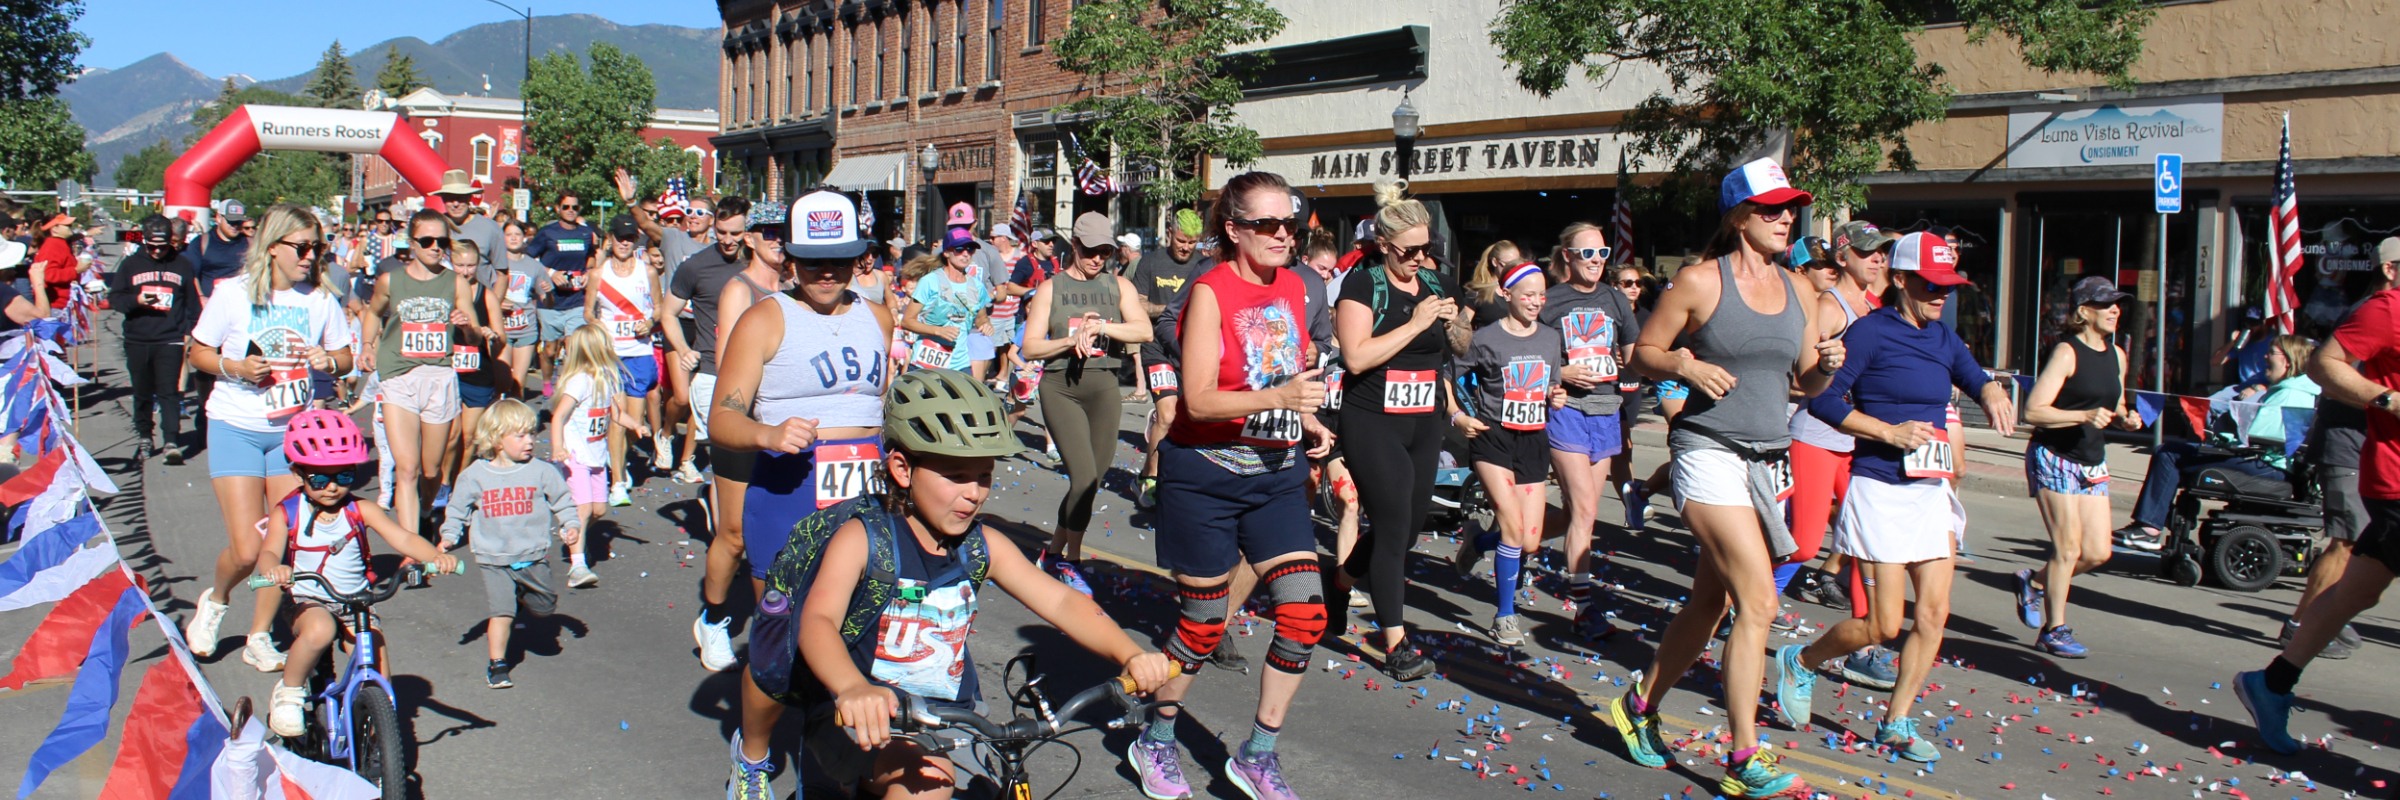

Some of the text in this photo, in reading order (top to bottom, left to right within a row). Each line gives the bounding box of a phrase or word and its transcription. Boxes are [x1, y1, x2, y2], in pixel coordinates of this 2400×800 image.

[262, 122, 381, 139] Runners Roost
[2041, 120, 2184, 143] Luna Vista Revival
[1310, 151, 1370, 179] MAIN
[1482, 138, 1600, 170] TAVERN
[1061, 293, 1115, 306] NOBULL
[247, 303, 312, 339] AMERICA
[404, 333, 444, 352] 4663
[454, 353, 478, 369] 540
[809, 346, 882, 389] USA
[918, 347, 951, 368] 4667
[265, 379, 309, 410] 4718
[1387, 382, 1434, 407] 4317
[1505, 400, 1545, 424] 4581
[1247, 409, 1300, 440] 4446
[482, 486, 537, 505] HEART
[482, 500, 533, 519] THROB
